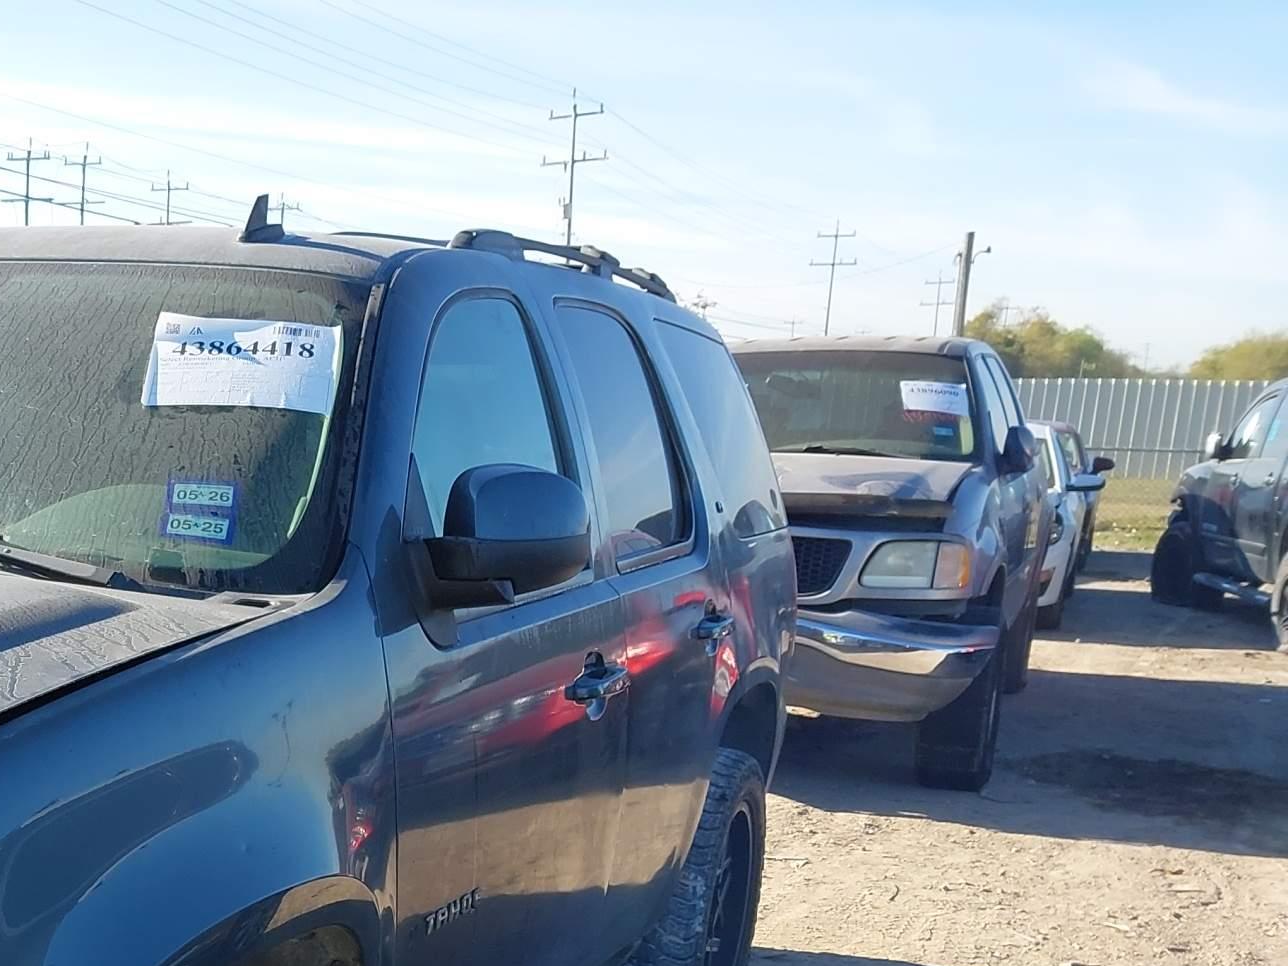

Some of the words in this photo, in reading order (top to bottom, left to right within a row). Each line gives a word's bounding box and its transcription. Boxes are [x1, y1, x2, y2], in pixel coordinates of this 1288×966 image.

[172, 340, 315, 359] 43864418
[176, 489, 199, 501] 05
[208, 490, 231, 503] 26
[170, 518, 193, 531] 05
[201, 521, 225, 534] 25
